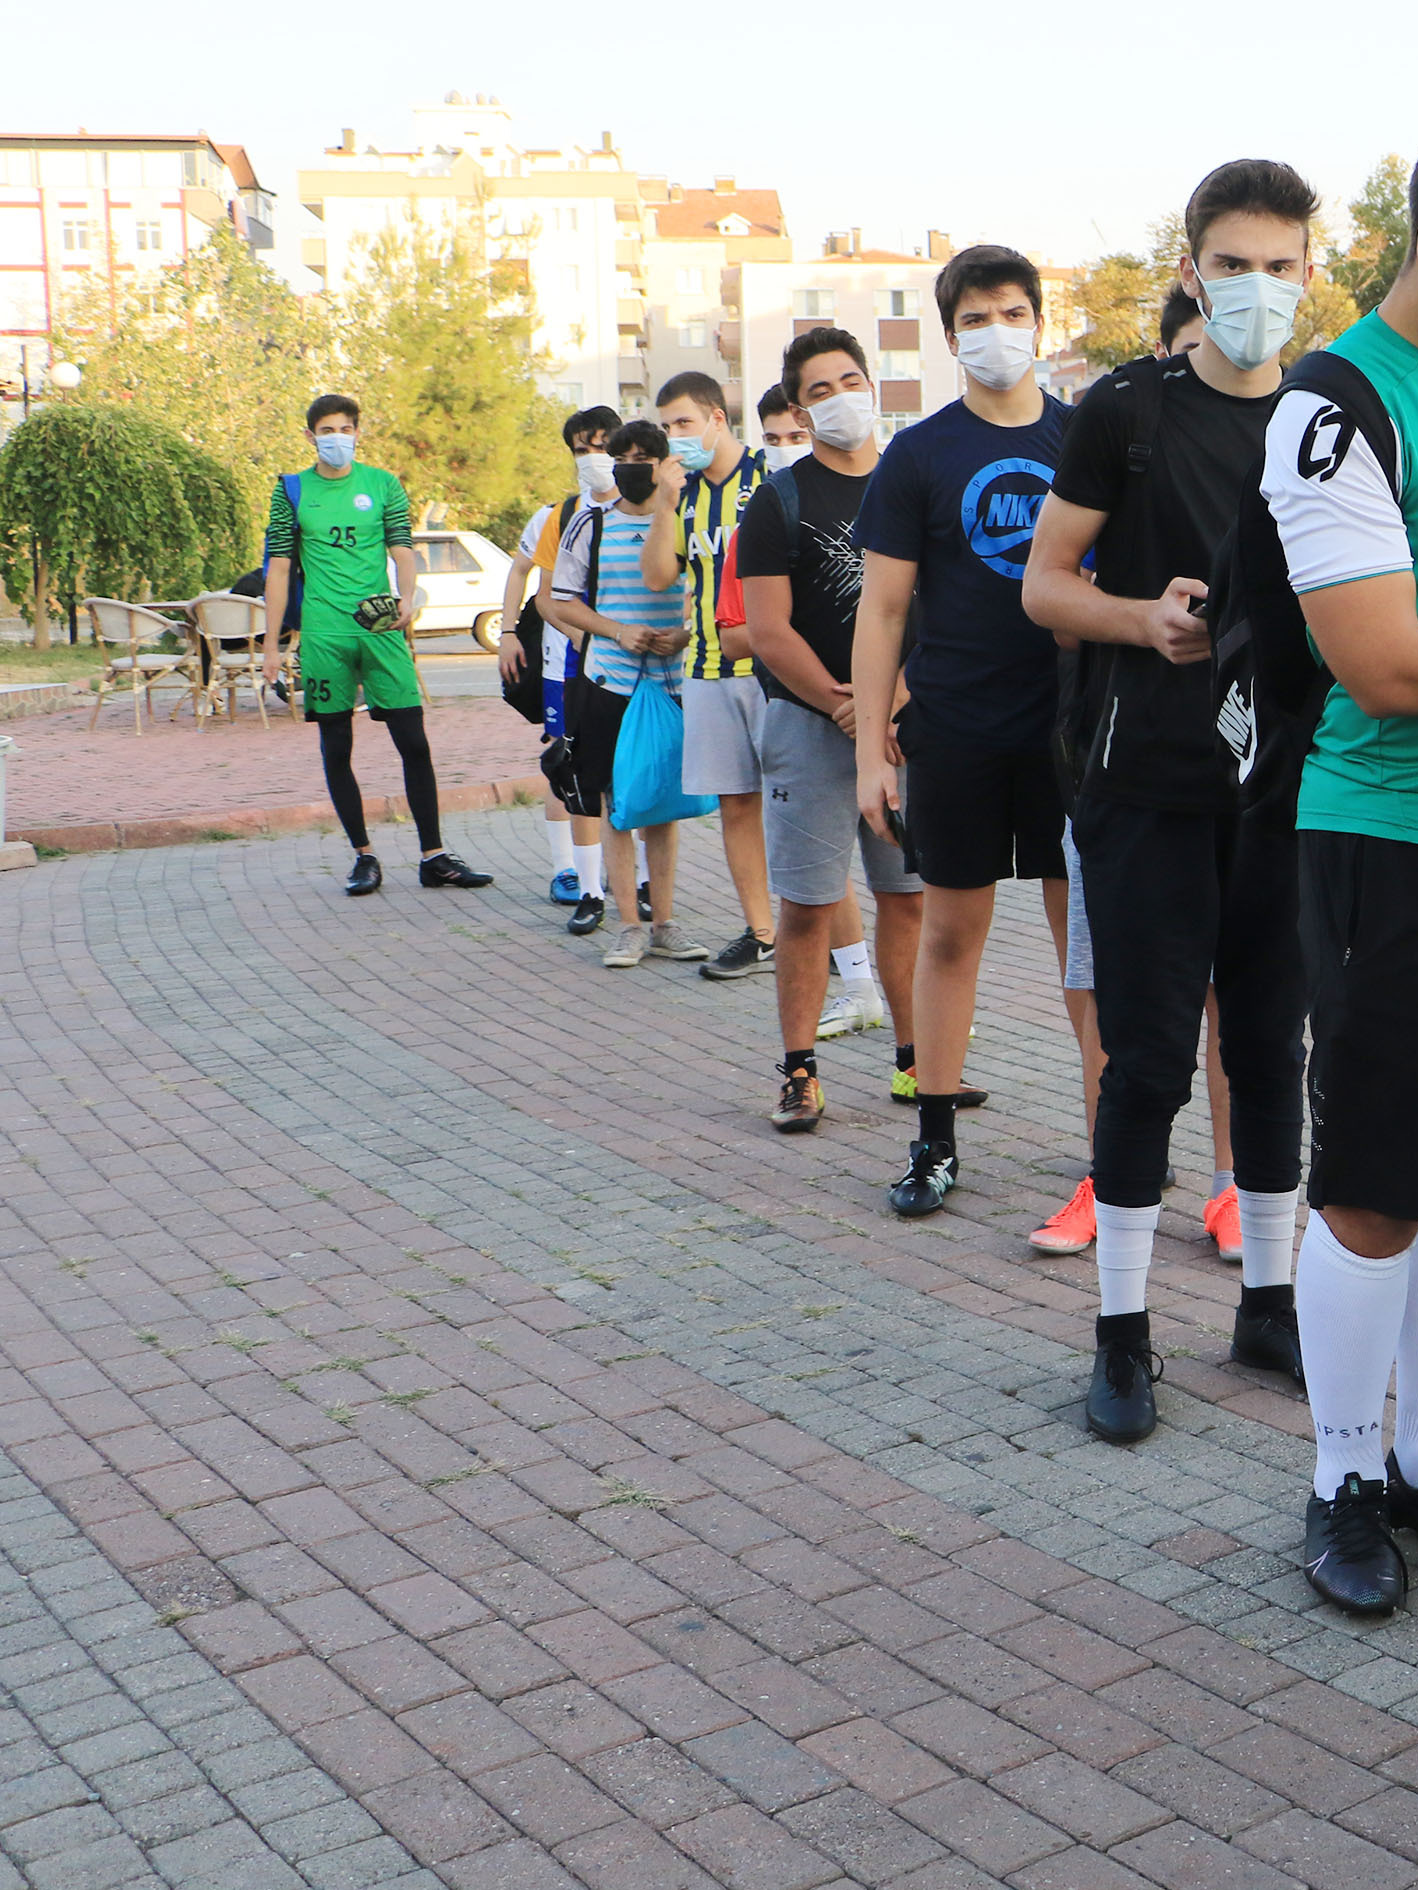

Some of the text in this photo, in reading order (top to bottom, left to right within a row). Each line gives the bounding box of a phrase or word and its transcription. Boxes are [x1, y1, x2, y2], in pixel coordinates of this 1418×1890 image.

[329, 526, 357, 548] 25
[688, 523, 741, 561] AVI
[307, 678, 332, 702] 25
[1316, 1421, 1379, 1438] IPSTA
